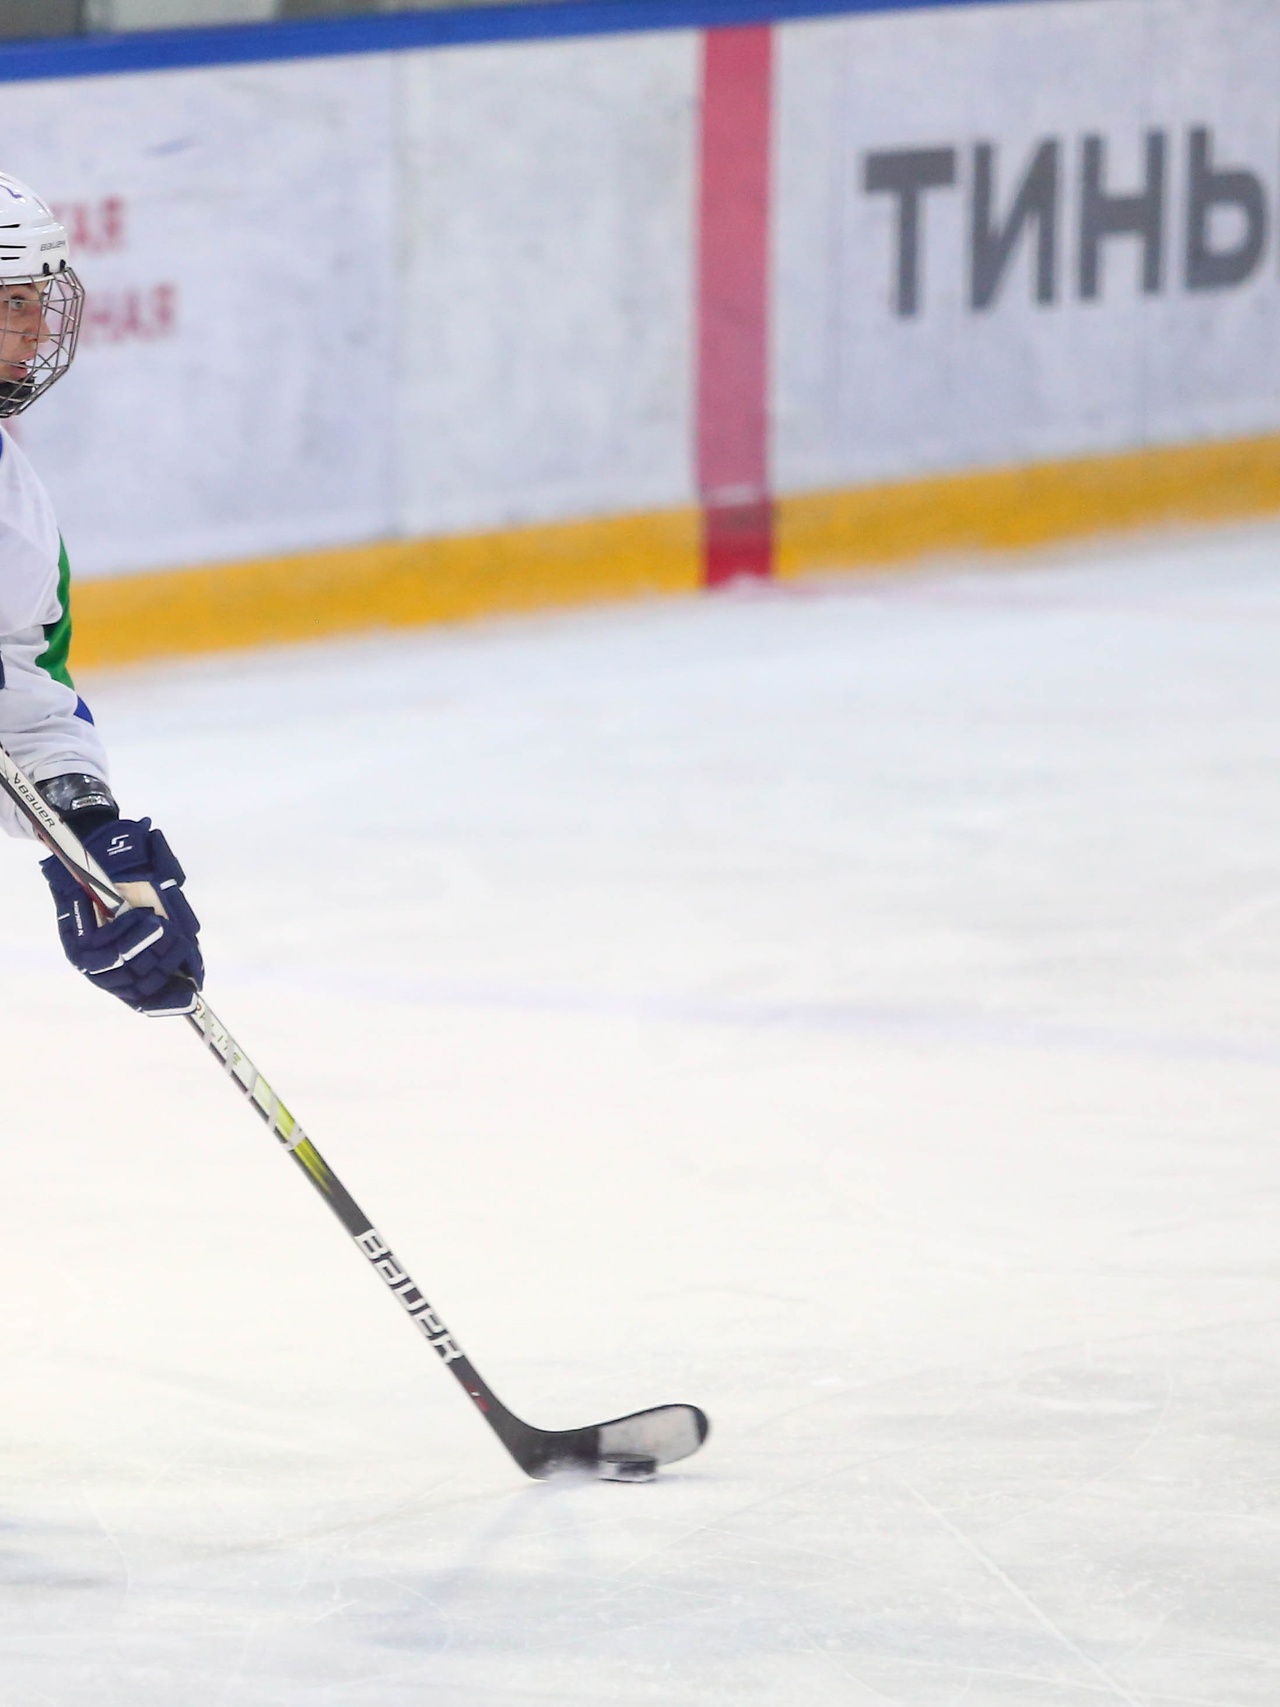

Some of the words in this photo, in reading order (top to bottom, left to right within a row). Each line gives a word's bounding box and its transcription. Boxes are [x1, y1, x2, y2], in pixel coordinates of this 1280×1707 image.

[53, 196, 126, 256] АЯ
[862, 124, 1280, 320] ТИНЬ
[354, 1229, 466, 1366] BAUER
